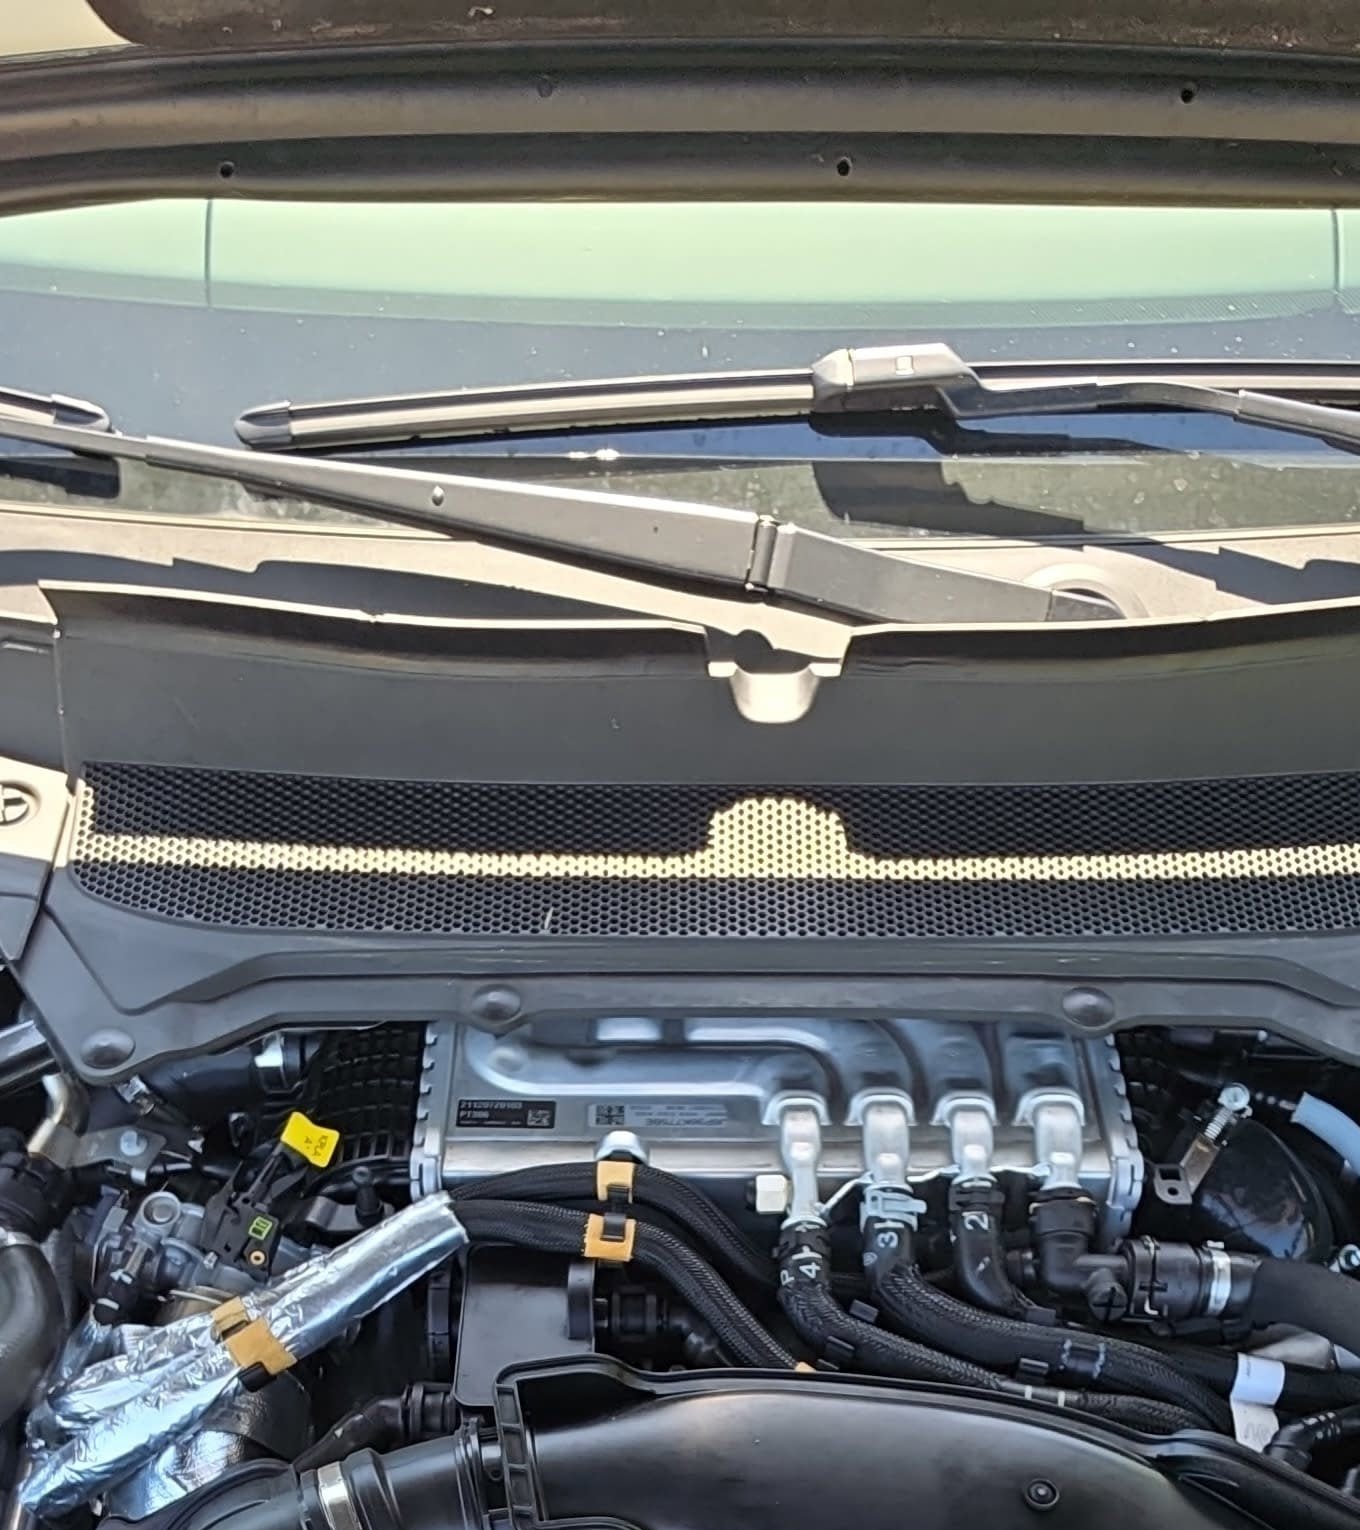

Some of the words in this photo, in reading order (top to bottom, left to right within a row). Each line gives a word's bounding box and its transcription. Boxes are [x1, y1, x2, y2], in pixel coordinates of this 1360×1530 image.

[963, 1214, 989, 1232] 2
[876, 1231, 899, 1249] 3
[798, 1261, 822, 1280] 4
